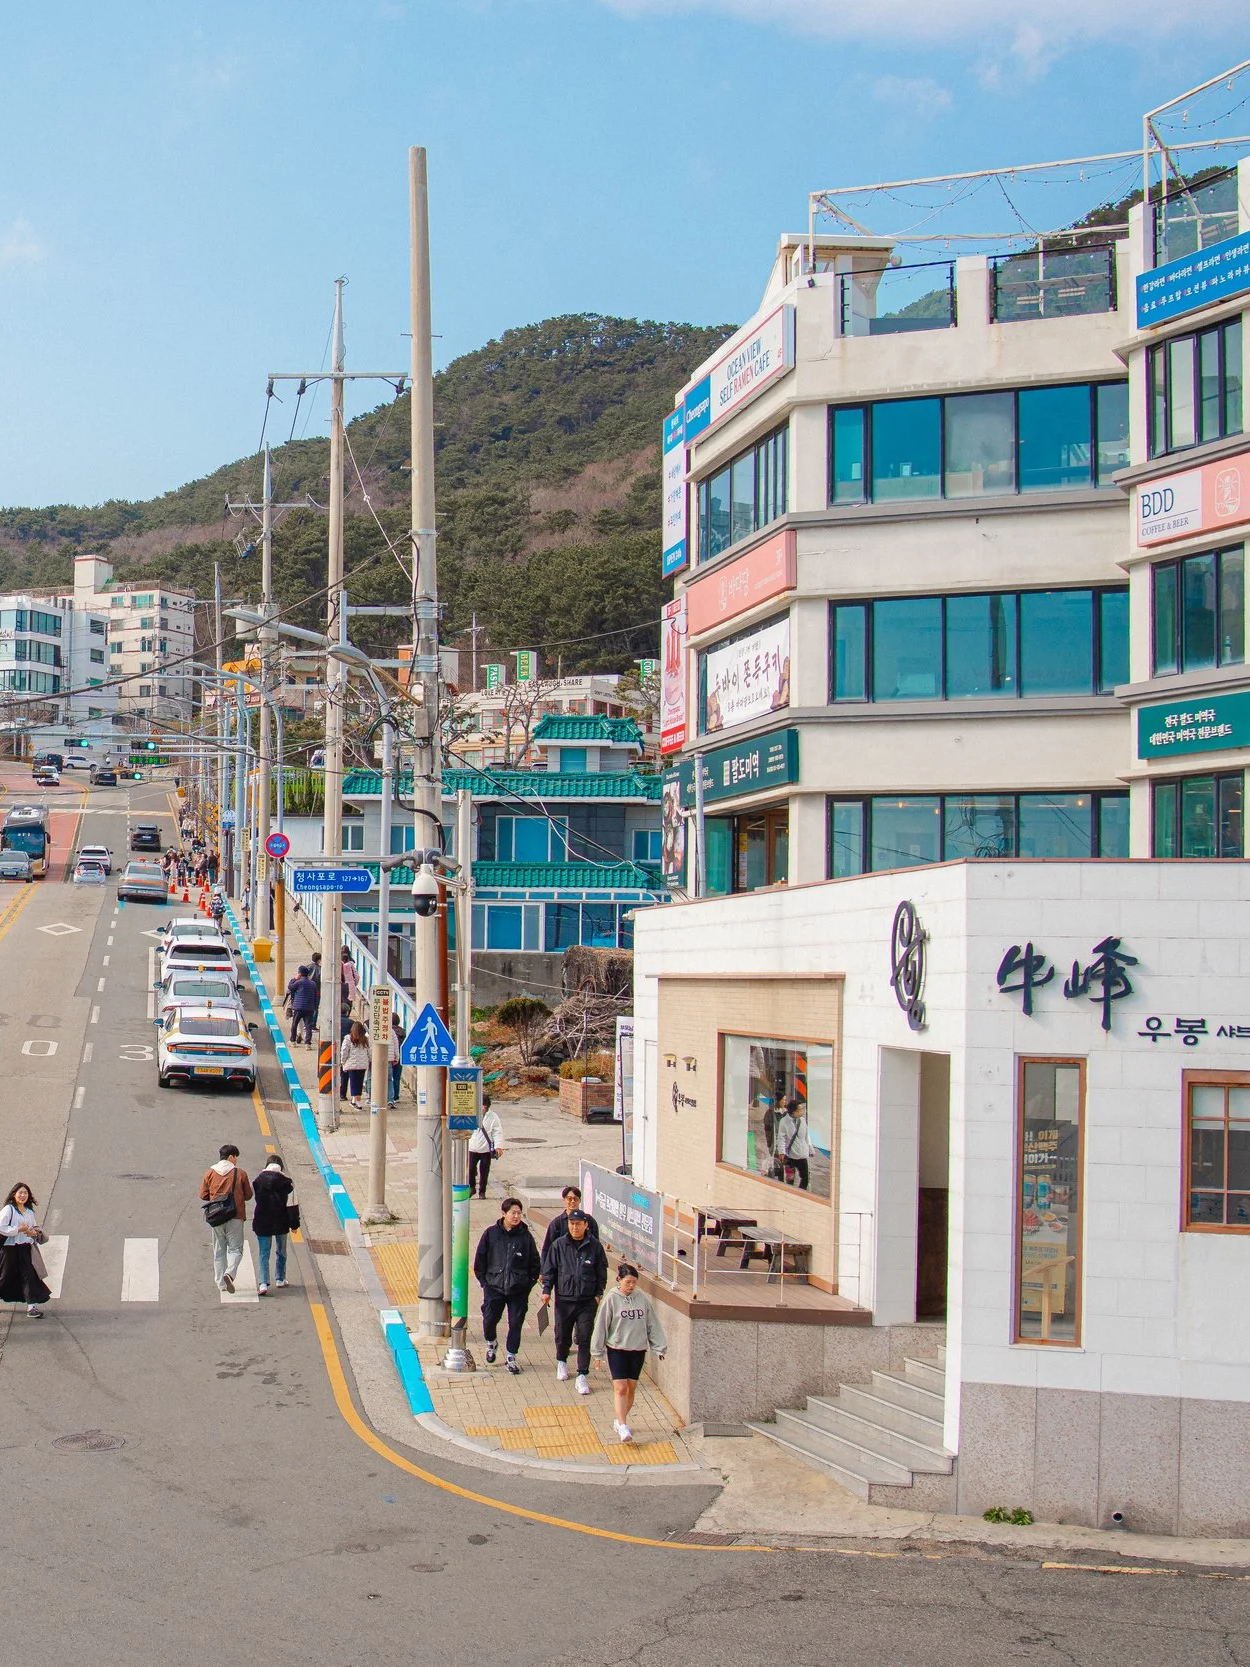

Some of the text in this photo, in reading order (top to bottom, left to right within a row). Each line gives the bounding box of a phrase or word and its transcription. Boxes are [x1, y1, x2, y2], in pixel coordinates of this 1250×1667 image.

[726, 338, 762, 381] OCEAN VIEW
[719, 349, 770, 407] SELF RAMEN CAFE
[1140, 488, 1175, 519] BDD
[1141, 523, 1166, 537] COFFEE
[1172, 517, 1190, 529] BEER
[520, 653, 529, 677] BEER
[563, 679, 582, 687] SHARE
[1164, 709, 1216, 728] 전국 팔도 미역국
[1149, 724, 1233, 746] 대한민국 미역국 전문브랜드
[731, 750, 759, 784] 팔도미역
[296, 872, 337, 883] 청사포로
[296, 883, 344, 891] Cheongsapo-ro
[381, 998, 389, 1041] 불법주정차
[1137, 1016, 1208, 1046] 우봉
[409, 1053, 449, 1062] 횡단보도
